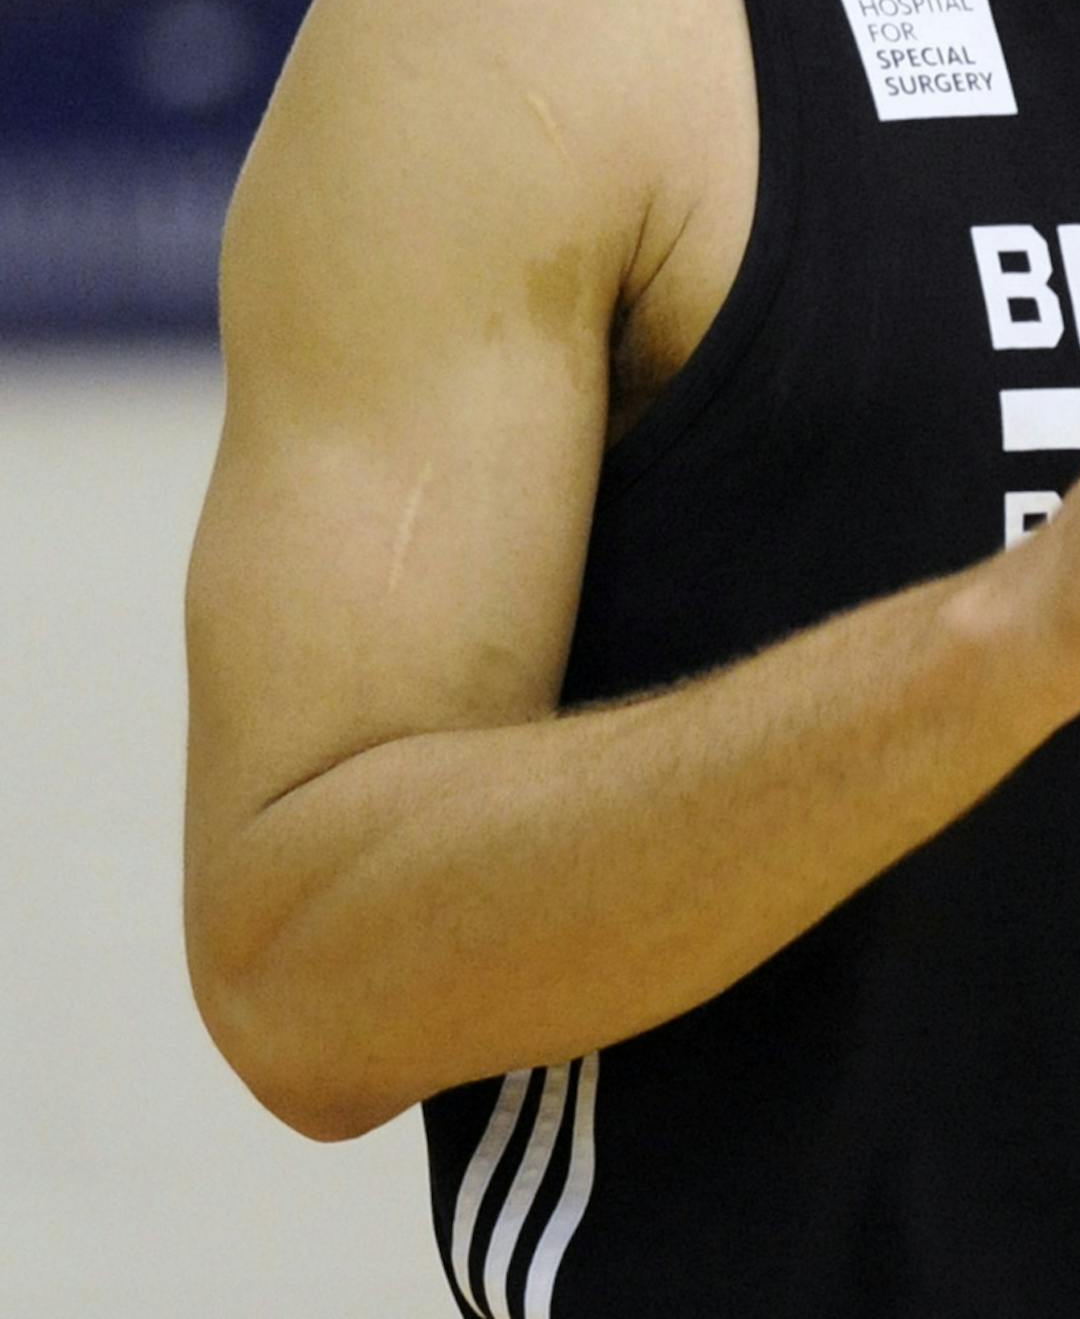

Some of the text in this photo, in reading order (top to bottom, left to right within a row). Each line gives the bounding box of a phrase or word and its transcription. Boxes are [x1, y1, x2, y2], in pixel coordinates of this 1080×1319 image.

[867, 21, 918, 43] FOR
[876, 45, 976, 70] SPECIAL
[884, 72, 993, 97] SURGERY
